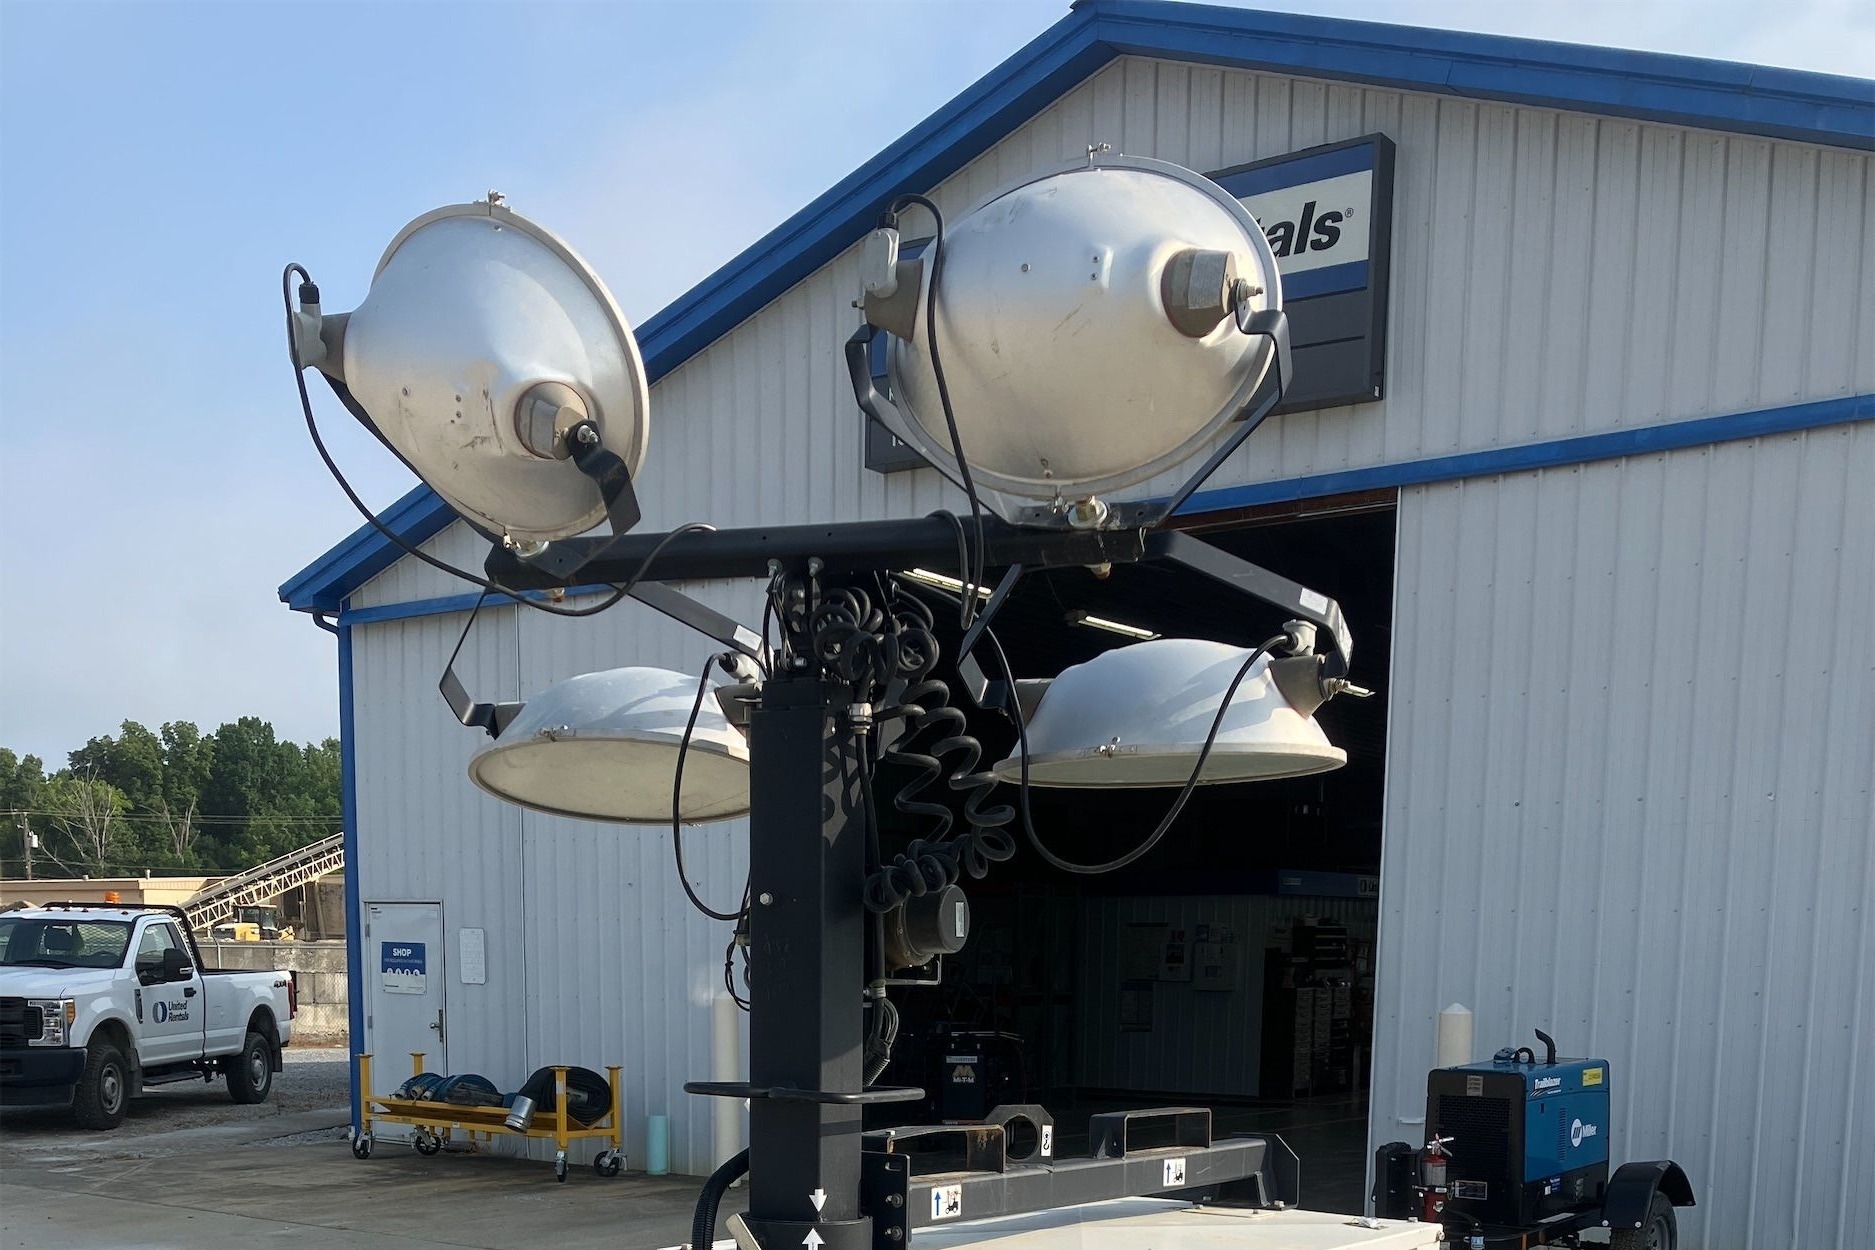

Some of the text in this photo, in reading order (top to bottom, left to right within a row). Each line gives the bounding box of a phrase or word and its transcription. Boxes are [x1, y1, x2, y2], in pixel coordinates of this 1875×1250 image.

[392, 948, 412, 957] SHOP
[168, 1000, 188, 1011] United
[168, 1012, 189, 1021] Rentals
[1582, 1124, 1597, 1138] Miller
